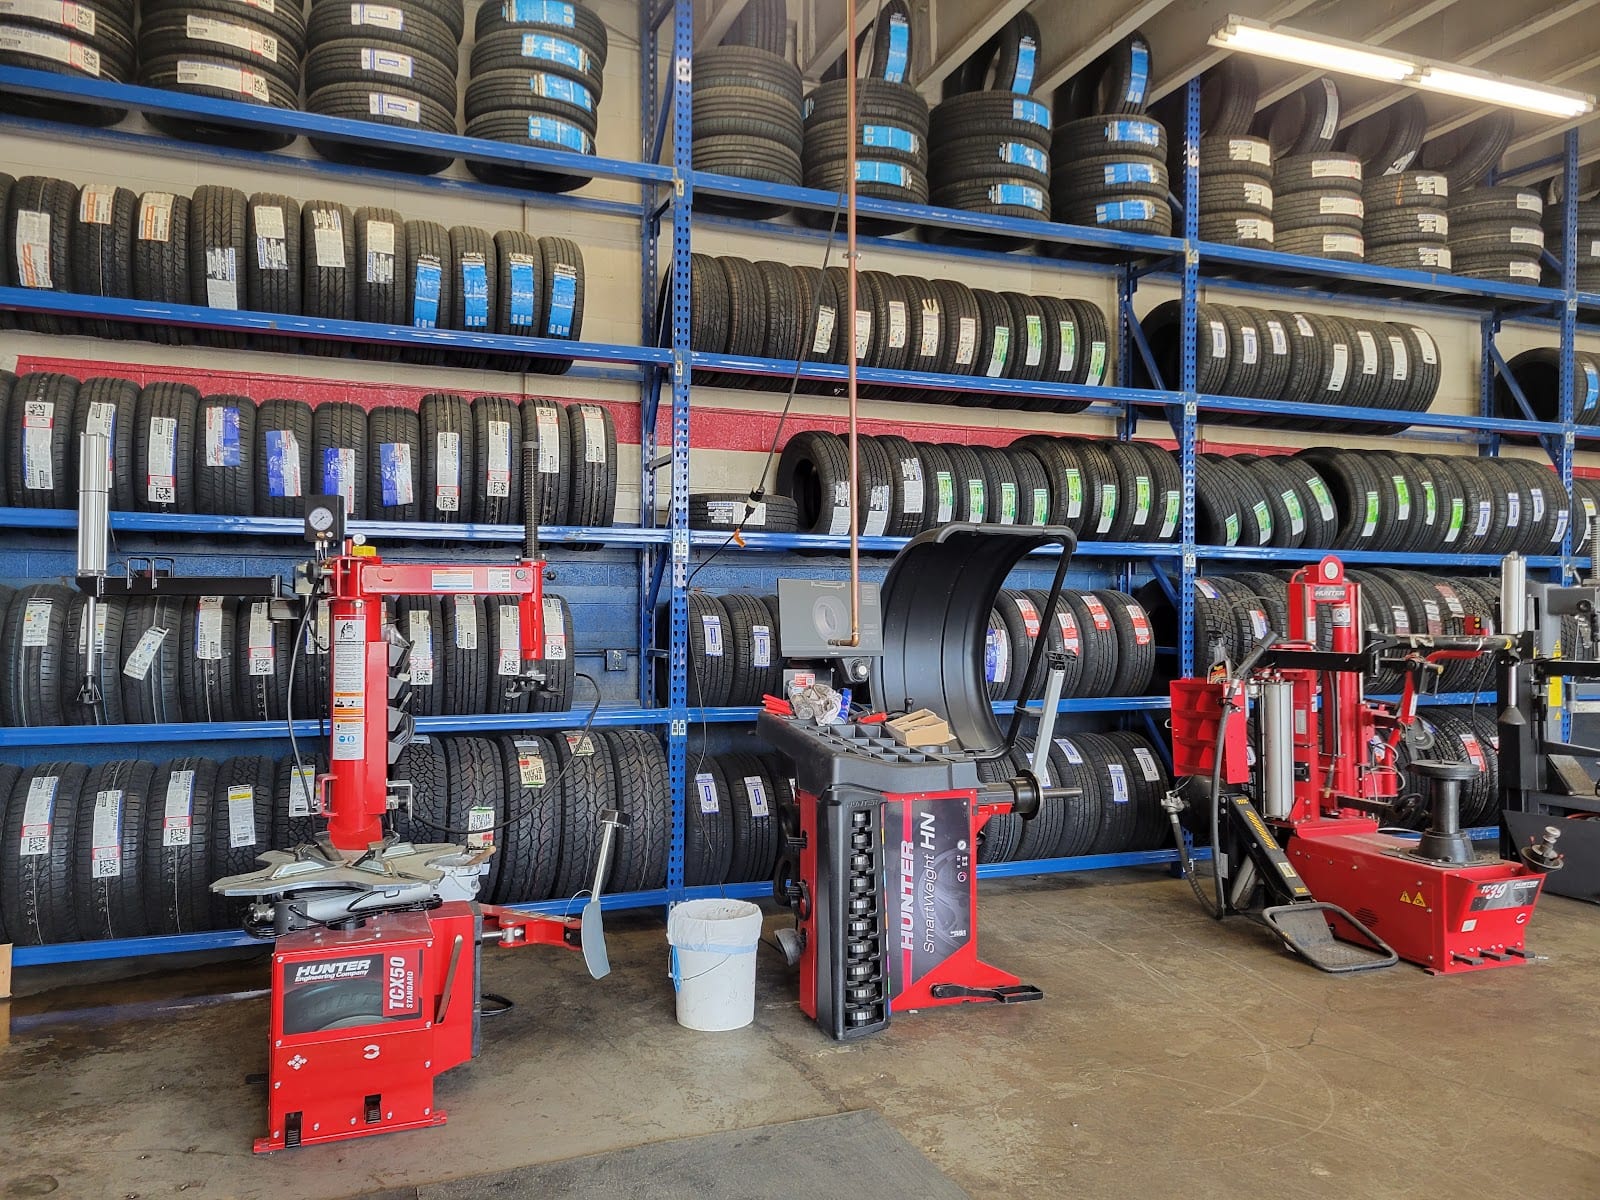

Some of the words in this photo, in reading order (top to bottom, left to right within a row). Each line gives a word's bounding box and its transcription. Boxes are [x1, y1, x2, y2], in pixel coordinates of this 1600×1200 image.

[921, 812, 936, 850] HN
[901, 840, 914, 951] HUNTER
[923, 854, 937, 953] SmartWeight
[295, 973, 335, 982] Engineering
[336, 970, 369, 978] Company
[296, 960, 371, 977] HUNTER
[389, 956, 405, 1010] TCX50
[406, 971, 414, 1009] STANDARD
